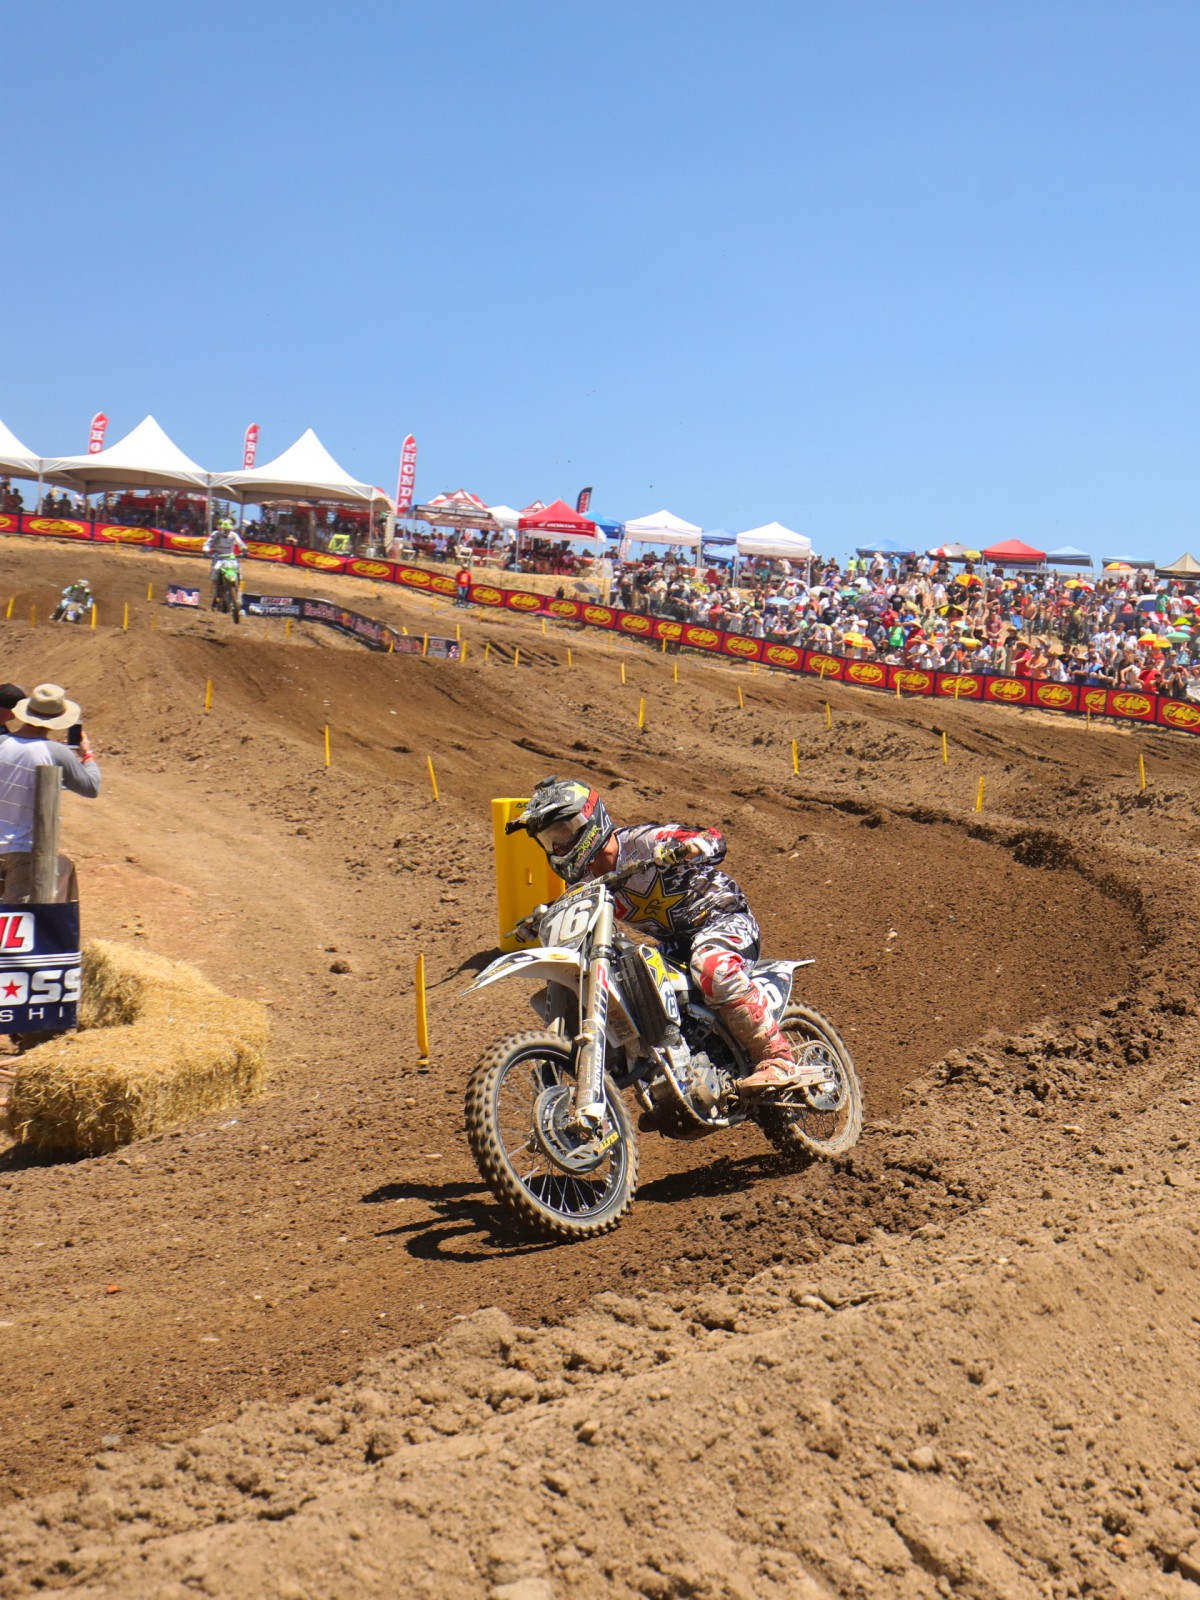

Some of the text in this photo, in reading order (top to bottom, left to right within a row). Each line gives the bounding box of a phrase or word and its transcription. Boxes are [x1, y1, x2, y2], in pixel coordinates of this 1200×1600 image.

[398, 453, 416, 508] HONDA
[687, 629, 719, 642] FMF
[727, 638, 758, 652] FMF
[767, 648, 798, 661] FMF
[849, 664, 883, 678] FMF
[893, 672, 930, 686] FMF
[941, 678, 977, 691] FMF
[990, 681, 1026, 694] FMF
[1037, 686, 1072, 701] FMF
[1113, 694, 1151, 711] FMF
[1162, 704, 1200, 720] FMF
[546, 899, 592, 947] 16
